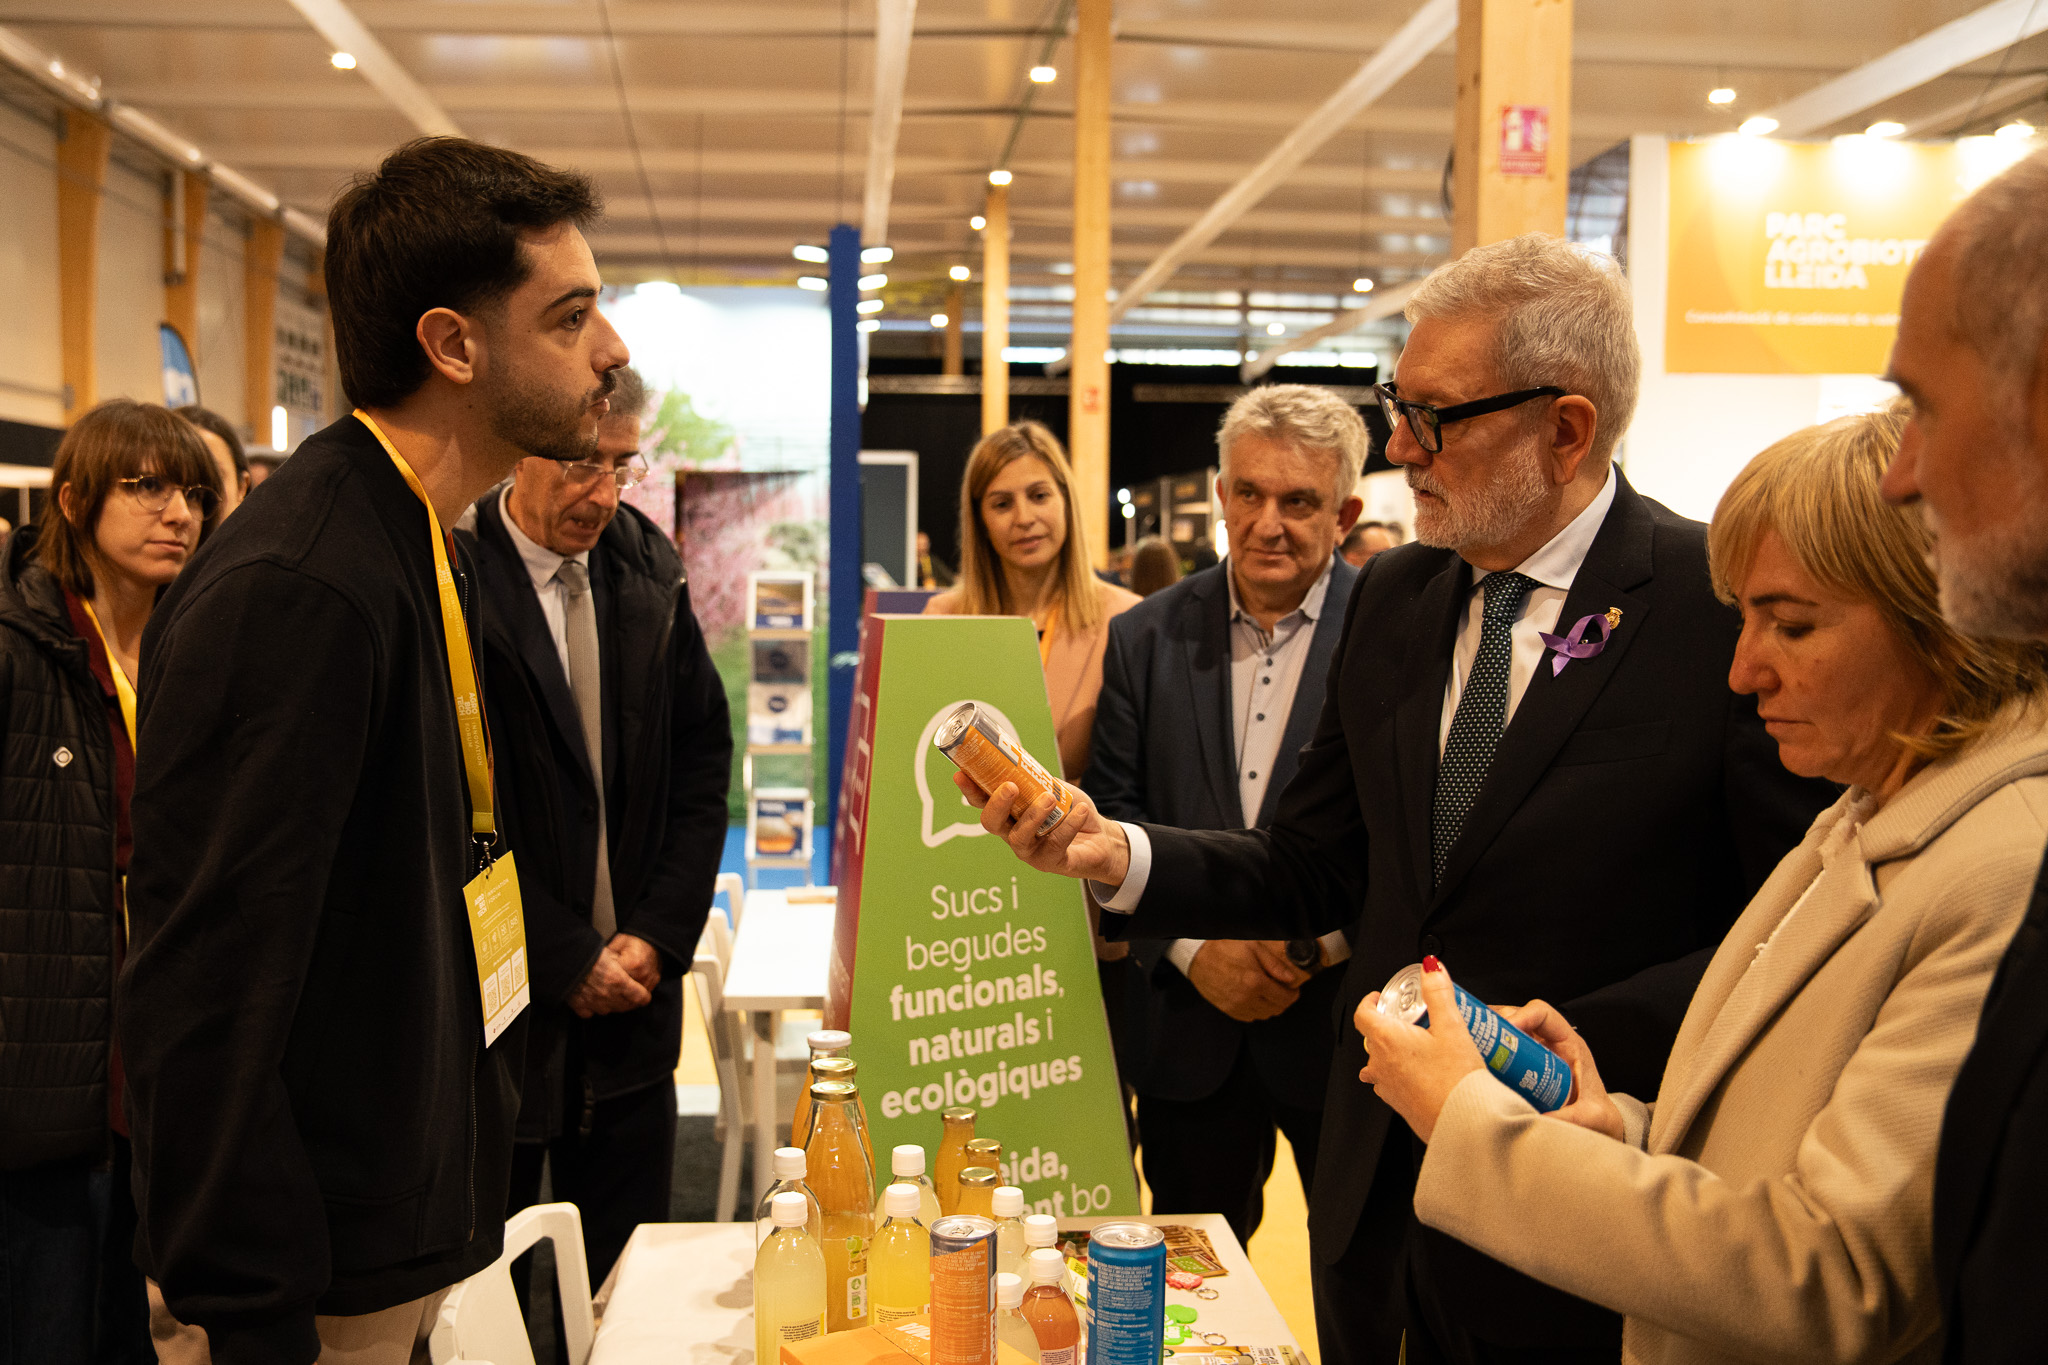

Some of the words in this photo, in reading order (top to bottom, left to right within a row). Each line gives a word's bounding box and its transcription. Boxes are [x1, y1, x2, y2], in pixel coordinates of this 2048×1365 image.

[1765, 212, 1846, 239] PARC
[1766, 238, 1927, 265] AGROBIOT
[1764, 264, 1868, 289] LLEIDA
[456, 695, 465, 716] TECH
[463, 701, 471, 715] BIO
[468, 691, 478, 714] AGRO
[463, 722, 473, 748] FORUM
[471, 721, 483, 766] INNOVATION
[931, 884, 1003, 920] Sucs
[1011, 876, 1018, 910] i
[905, 922, 1047, 972] begudes
[889, 963, 1065, 1021] funcionals,
[909, 1011, 1041, 1066] naturals
[1046, 1007, 1053, 1041] i
[881, 1055, 1083, 1119] ecològiques
[1000, 1146, 1069, 1186] eida,
[1071, 1182, 1111, 1216] bo
